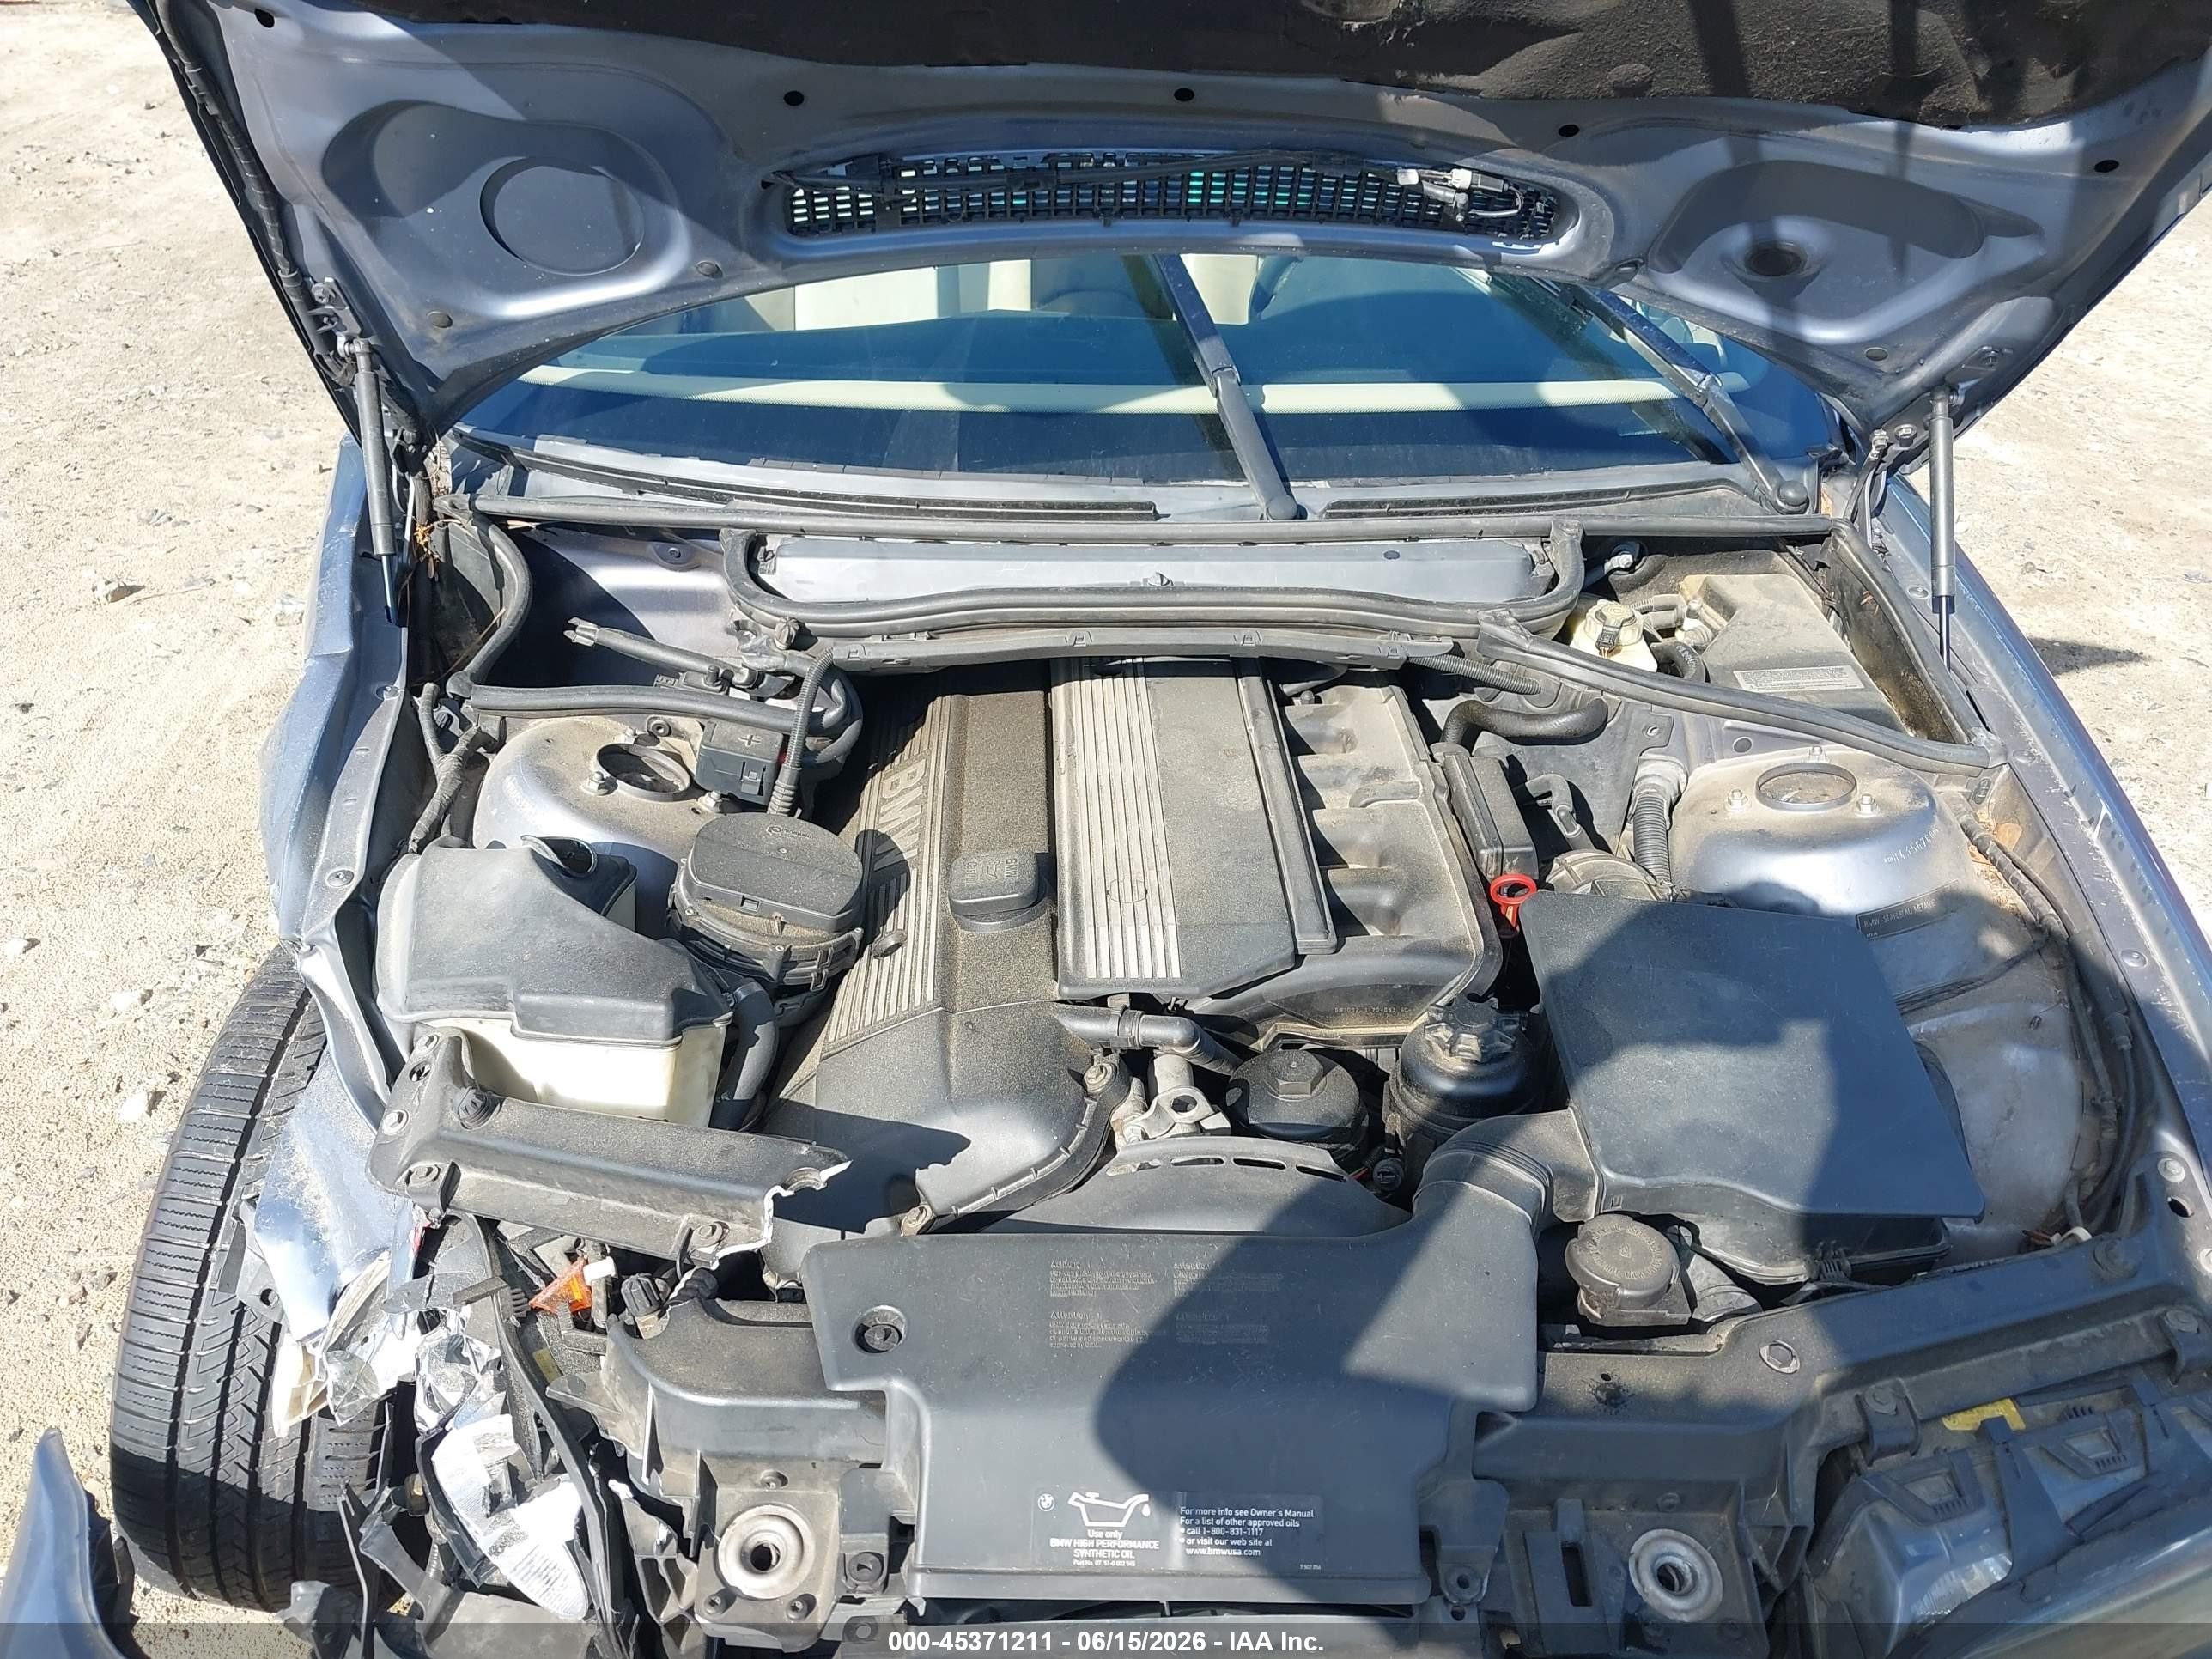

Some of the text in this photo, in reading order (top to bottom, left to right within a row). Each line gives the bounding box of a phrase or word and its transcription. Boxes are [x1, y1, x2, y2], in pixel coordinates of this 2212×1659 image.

[873, 758, 926, 872] BMW
[1180, 1506, 1194, 1516] For
[1218, 1507, 1233, 1516] info
[1285, 1509, 1314, 1518] Manual
[1180, 1516, 1194, 1525] For
[1201, 1517, 1214, 1526] list
[1215, 1517, 1224, 1526] of
[1225, 1517, 1246, 1527] other
[1248, 1518, 1284, 1528] approved
[1285, 1519, 1300, 1528] oils
[1087, 1529, 1124, 1540] Use only
[1186, 1527, 1264, 1536] call 1-800-831-1117
[1049, 1538, 1160, 1550] BMW HIGH PERFORMANCE
[1196, 1537, 1213, 1546] visit
[1230, 1538, 1247, 1547] web
[1249, 1538, 1263, 1547] site
[1073, 1549, 1135, 1559] SYNTHETIC OIL
[1186, 1547, 1261, 1556] www.bmwusa.com
